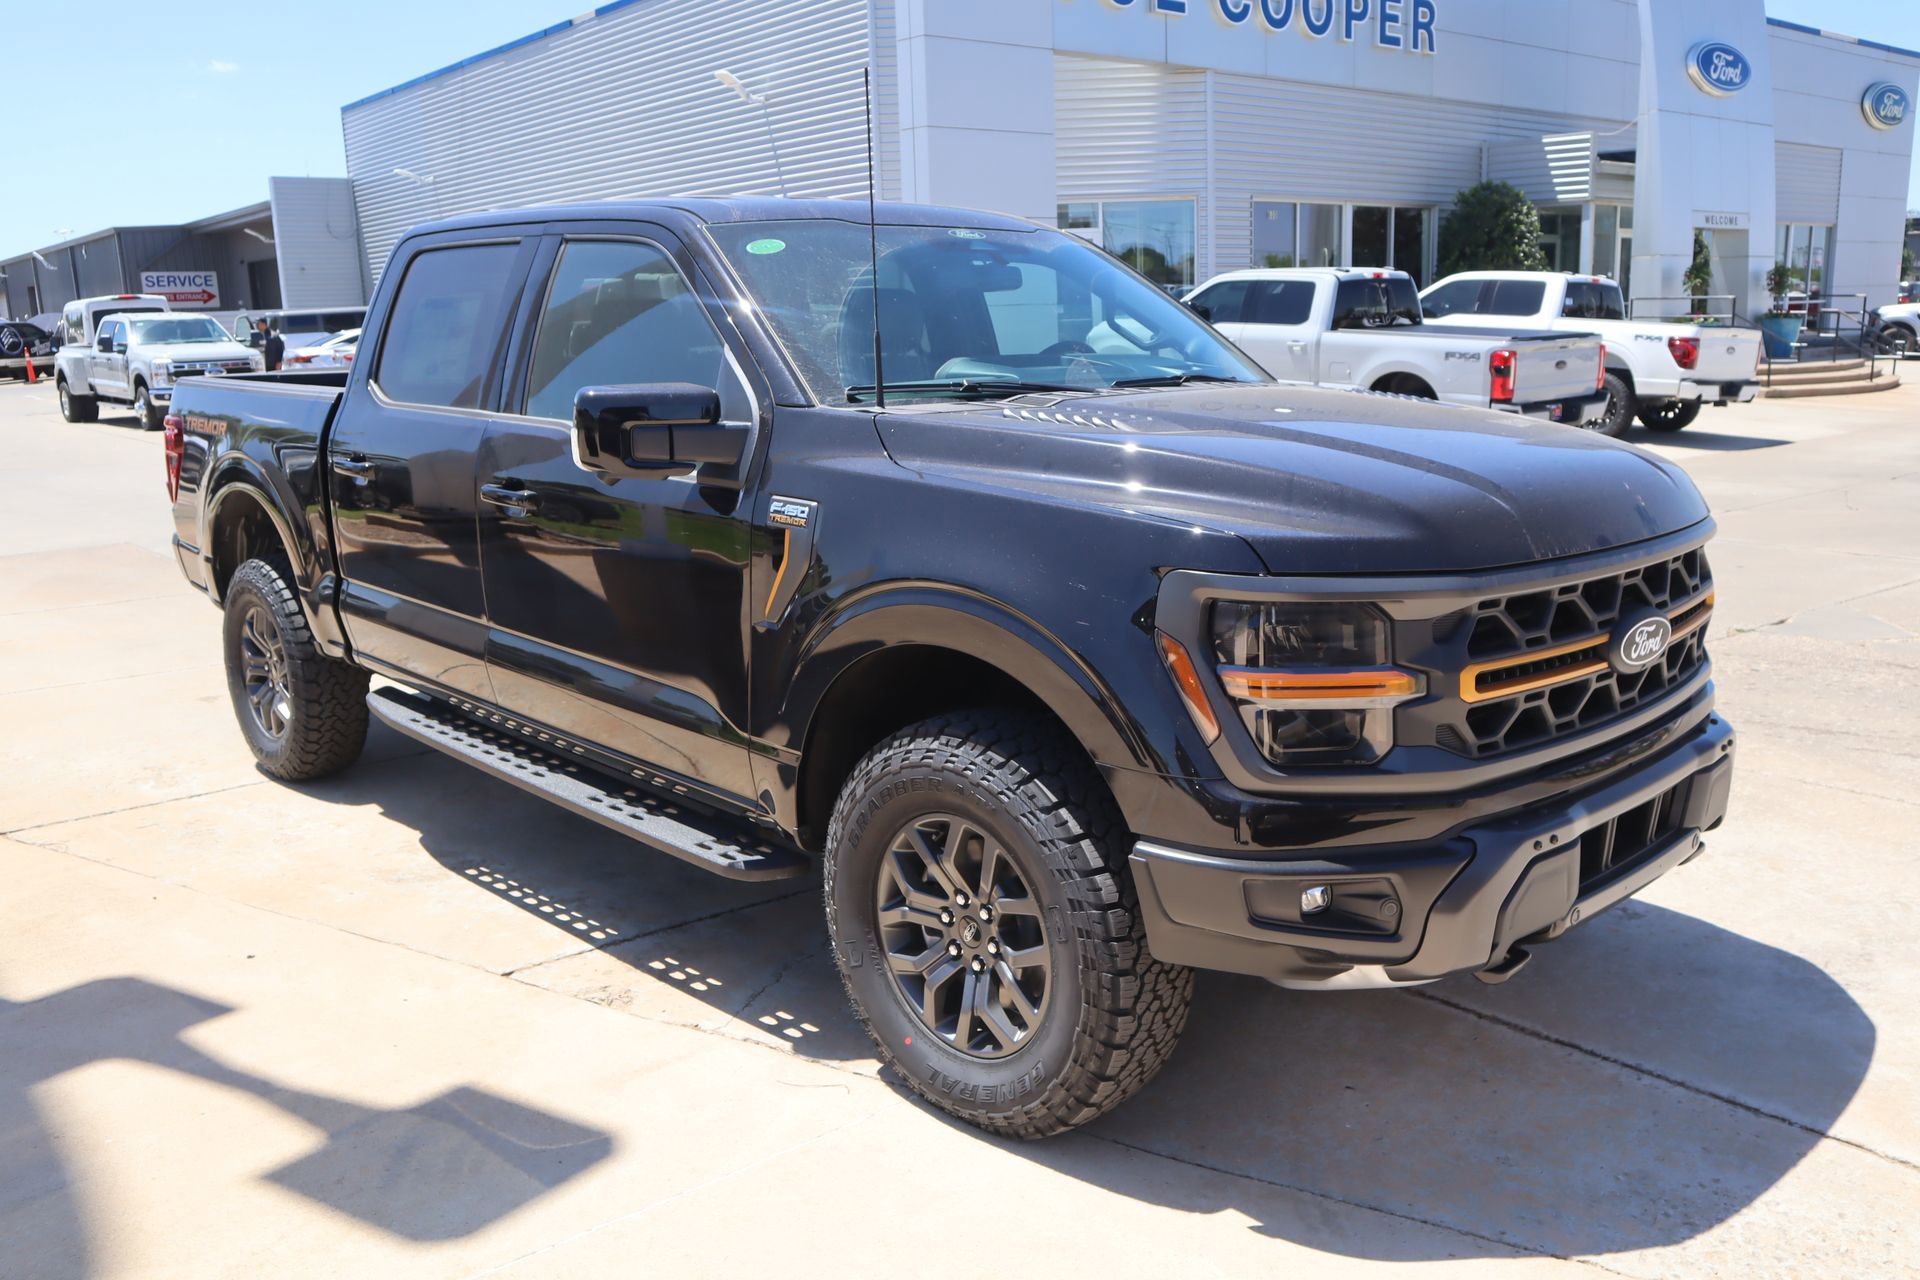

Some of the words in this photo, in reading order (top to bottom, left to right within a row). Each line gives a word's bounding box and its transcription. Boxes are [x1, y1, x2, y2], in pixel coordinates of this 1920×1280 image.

[1710, 51, 1742, 83] Ford
[1880, 92, 1905, 118] Ford
[1704, 215, 1739, 226] WELCOME
[144, 274, 214, 288] SERVICE
[175, 292, 209, 301] ENTRANCE
[1634, 334, 1664, 343] FX4
[1444, 351, 1481, 362] FX4
[185, 415, 228, 437] TREMOR
[769, 512, 808, 527] TREMOR
[1631, 624, 1664, 659] Ford
[848, 775, 944, 849] GRABBER
[925, 1059, 1046, 1103] GENERAL
